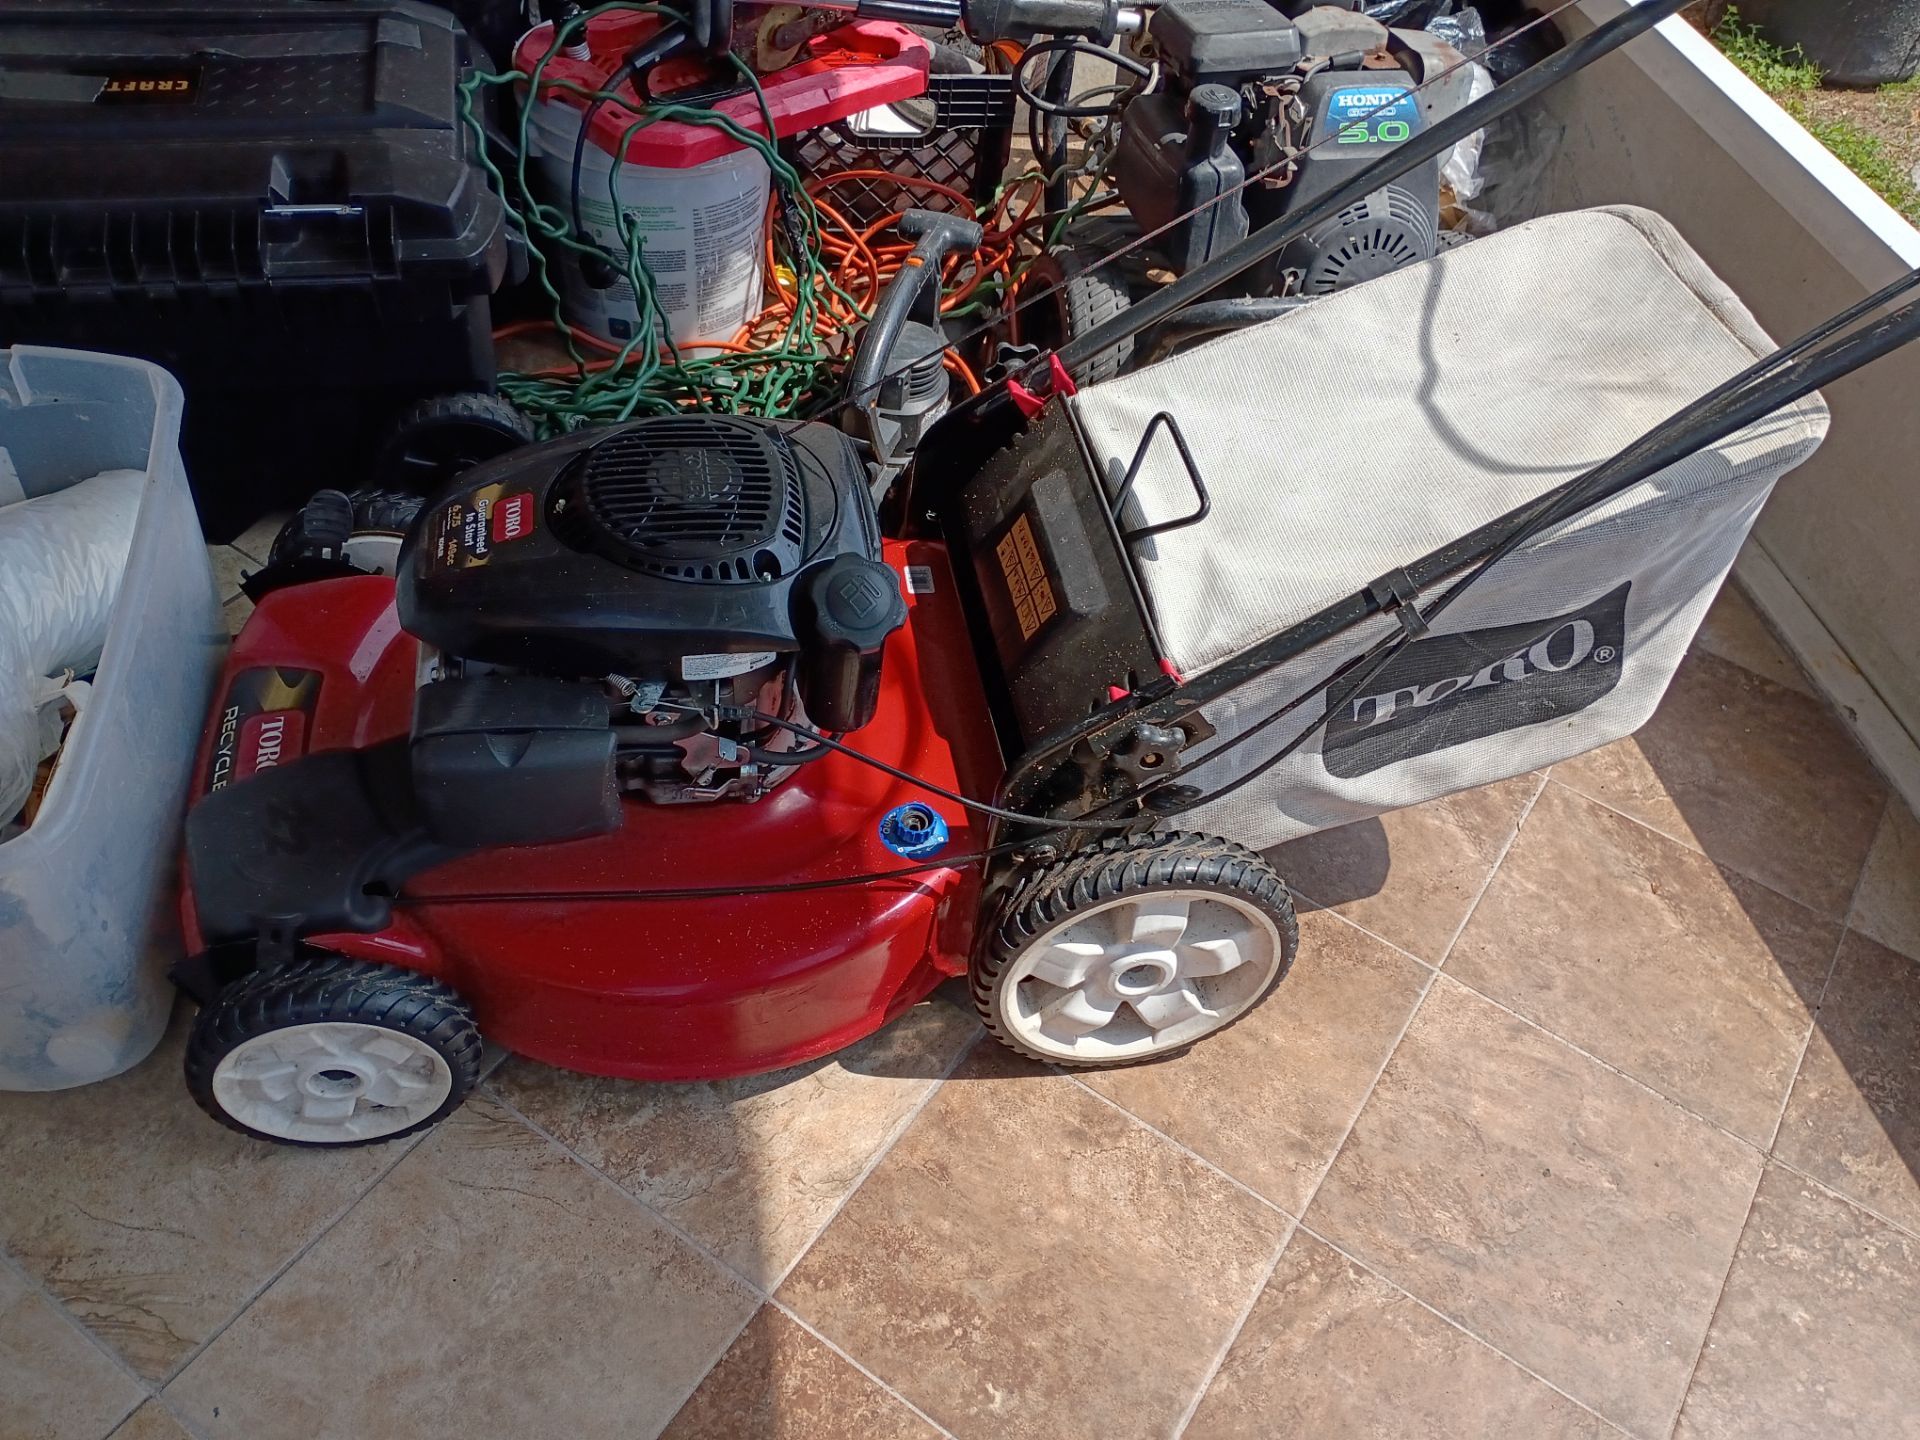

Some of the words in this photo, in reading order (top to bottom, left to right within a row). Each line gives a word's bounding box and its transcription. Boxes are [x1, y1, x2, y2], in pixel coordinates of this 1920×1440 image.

[1338, 121, 1410, 144] 5.0
[451, 504, 462, 528] 6.75
[465, 512, 476, 522] to
[476, 499, 489, 555] Guaranteed
[505, 498, 521, 539] TORO
[464, 523, 476, 546] Start
